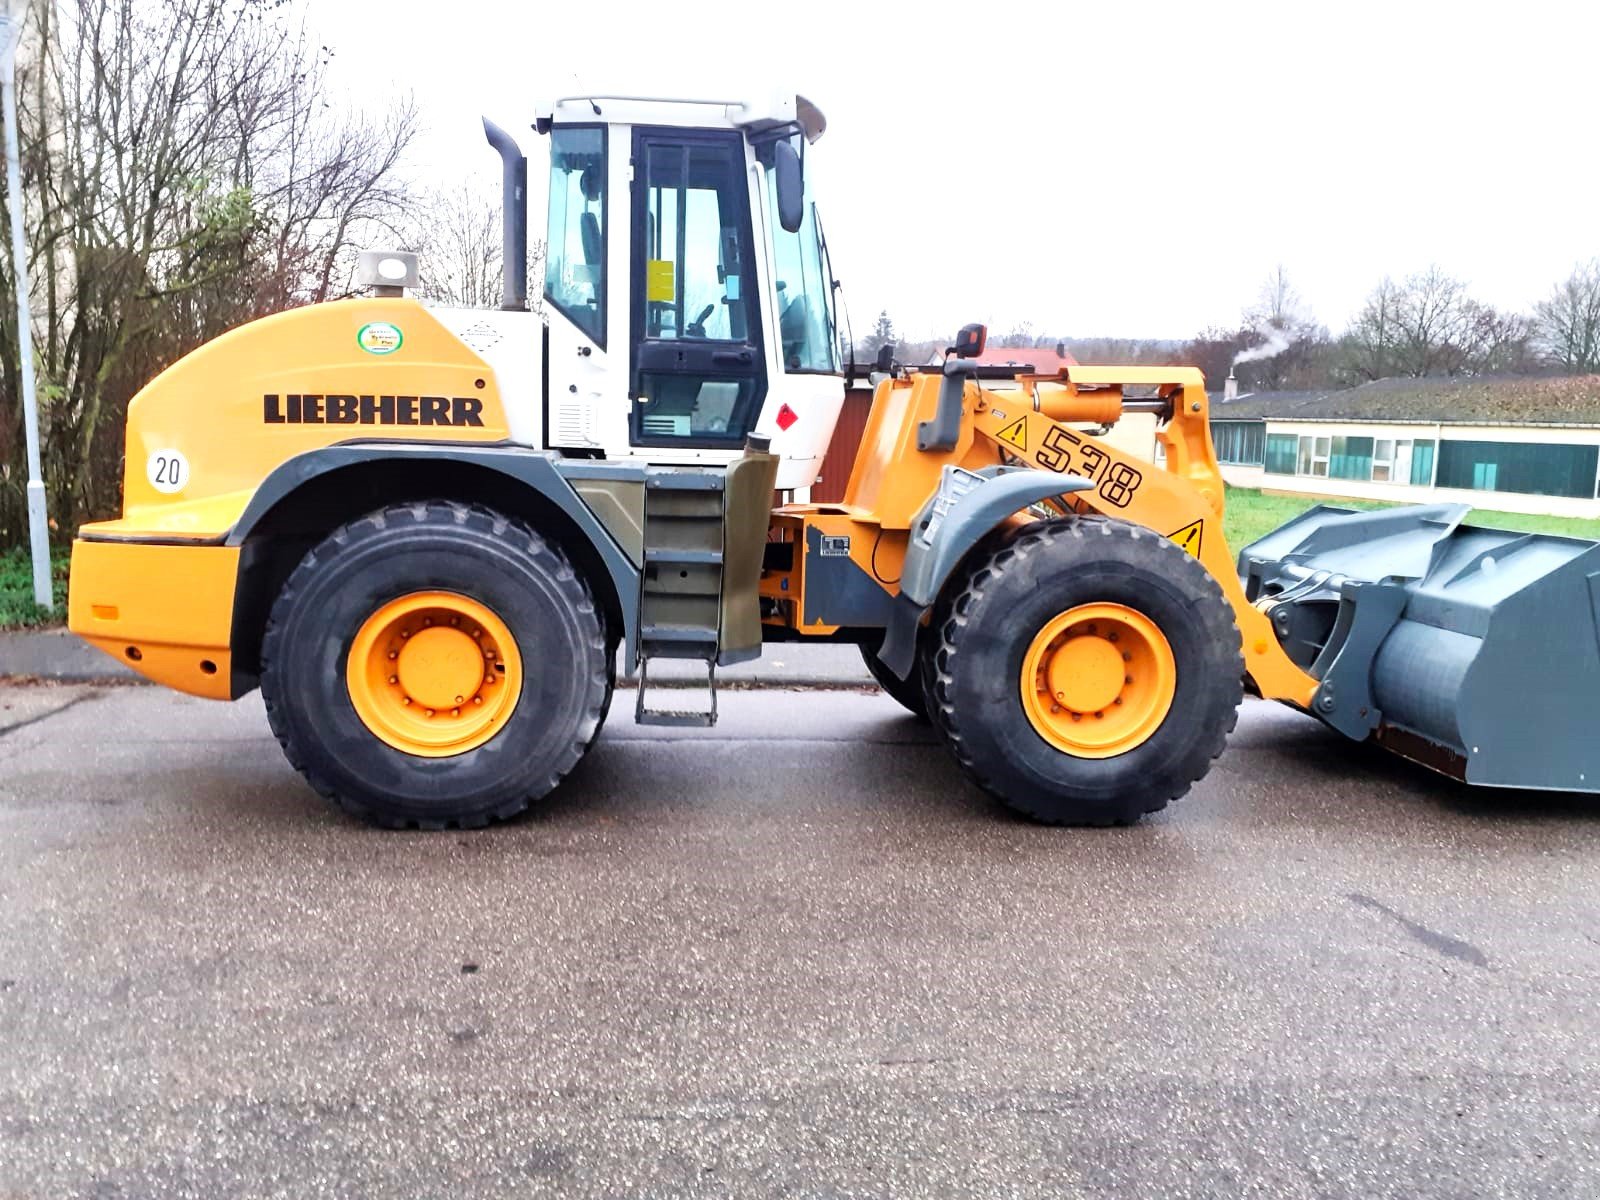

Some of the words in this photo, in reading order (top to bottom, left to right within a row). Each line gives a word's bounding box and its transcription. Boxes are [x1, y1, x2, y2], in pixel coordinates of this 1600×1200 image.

[264, 394, 484, 426] LIEBHERR
[155, 457, 180, 485] 20
[1036, 425, 1142, 508] 538
